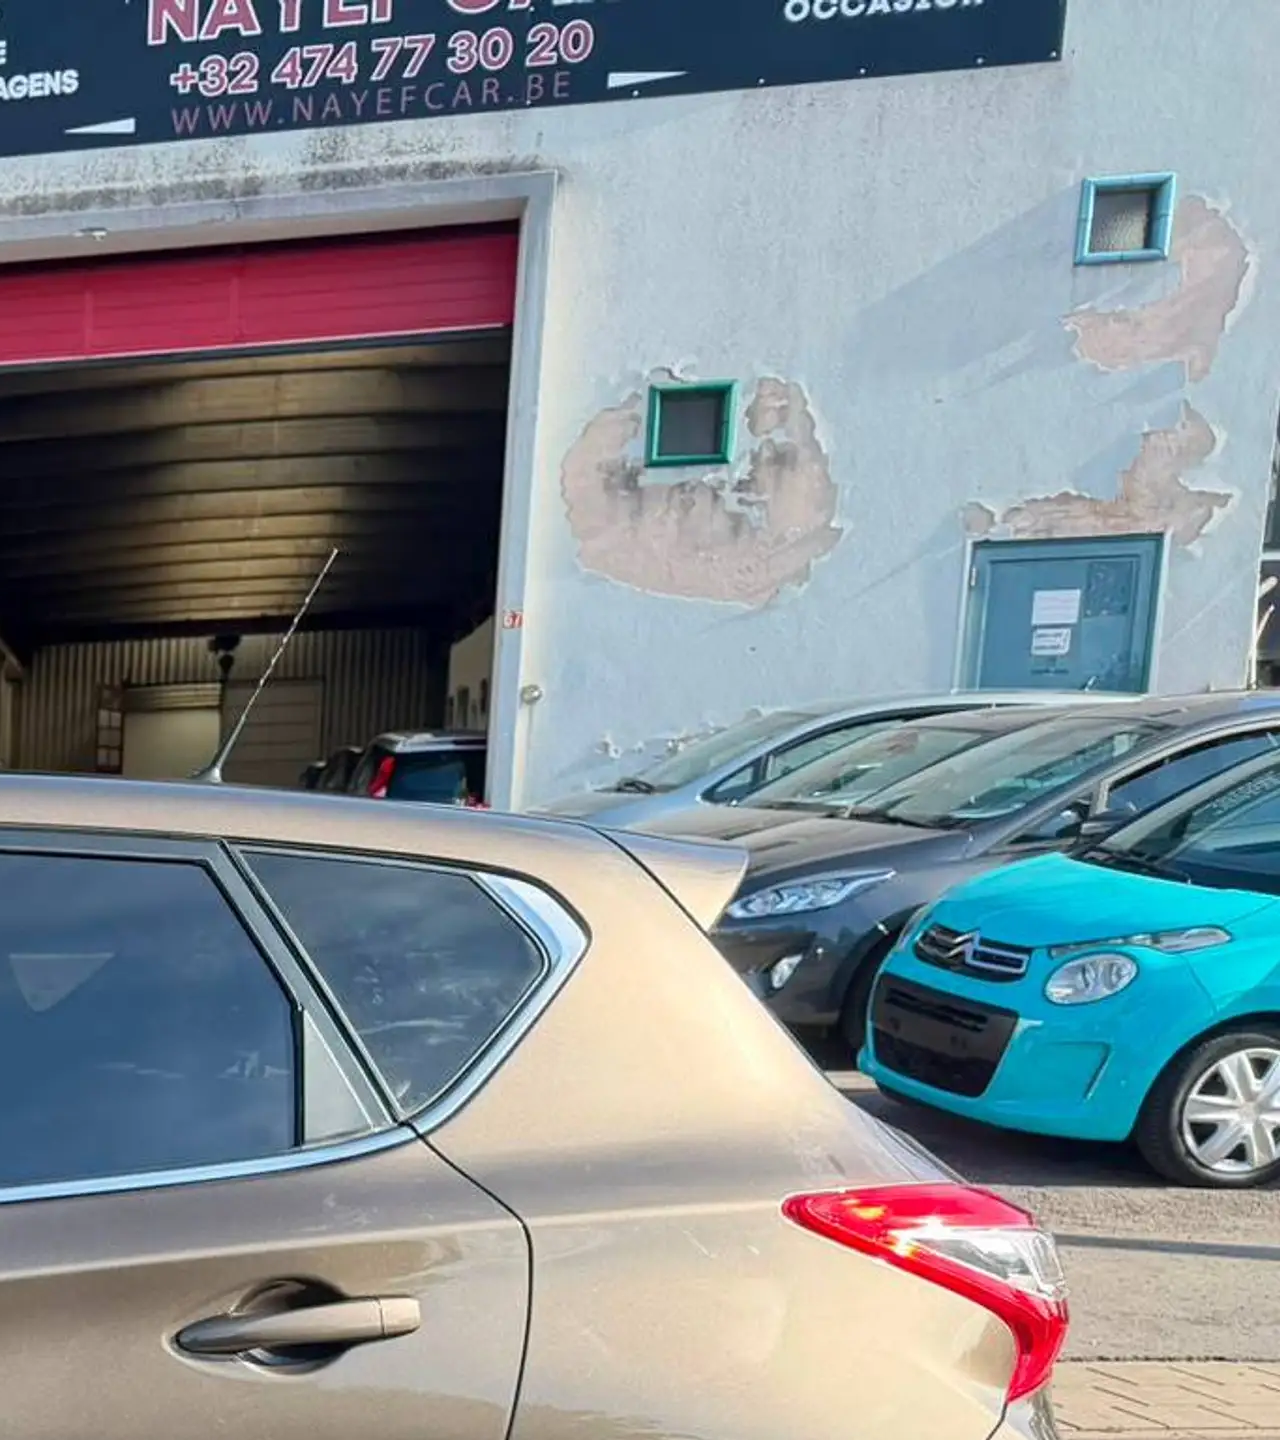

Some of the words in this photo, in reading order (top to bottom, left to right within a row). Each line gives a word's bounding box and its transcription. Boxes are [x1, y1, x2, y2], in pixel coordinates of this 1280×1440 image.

[170, 53, 259, 97] +32
[271, 42, 358, 89] 474
[370, 34, 435, 81] 77
[447, 26, 513, 74] 30
[525, 19, 594, 68] 20
[170, 71, 572, 135] WWW.NAYEFCAR.BE
